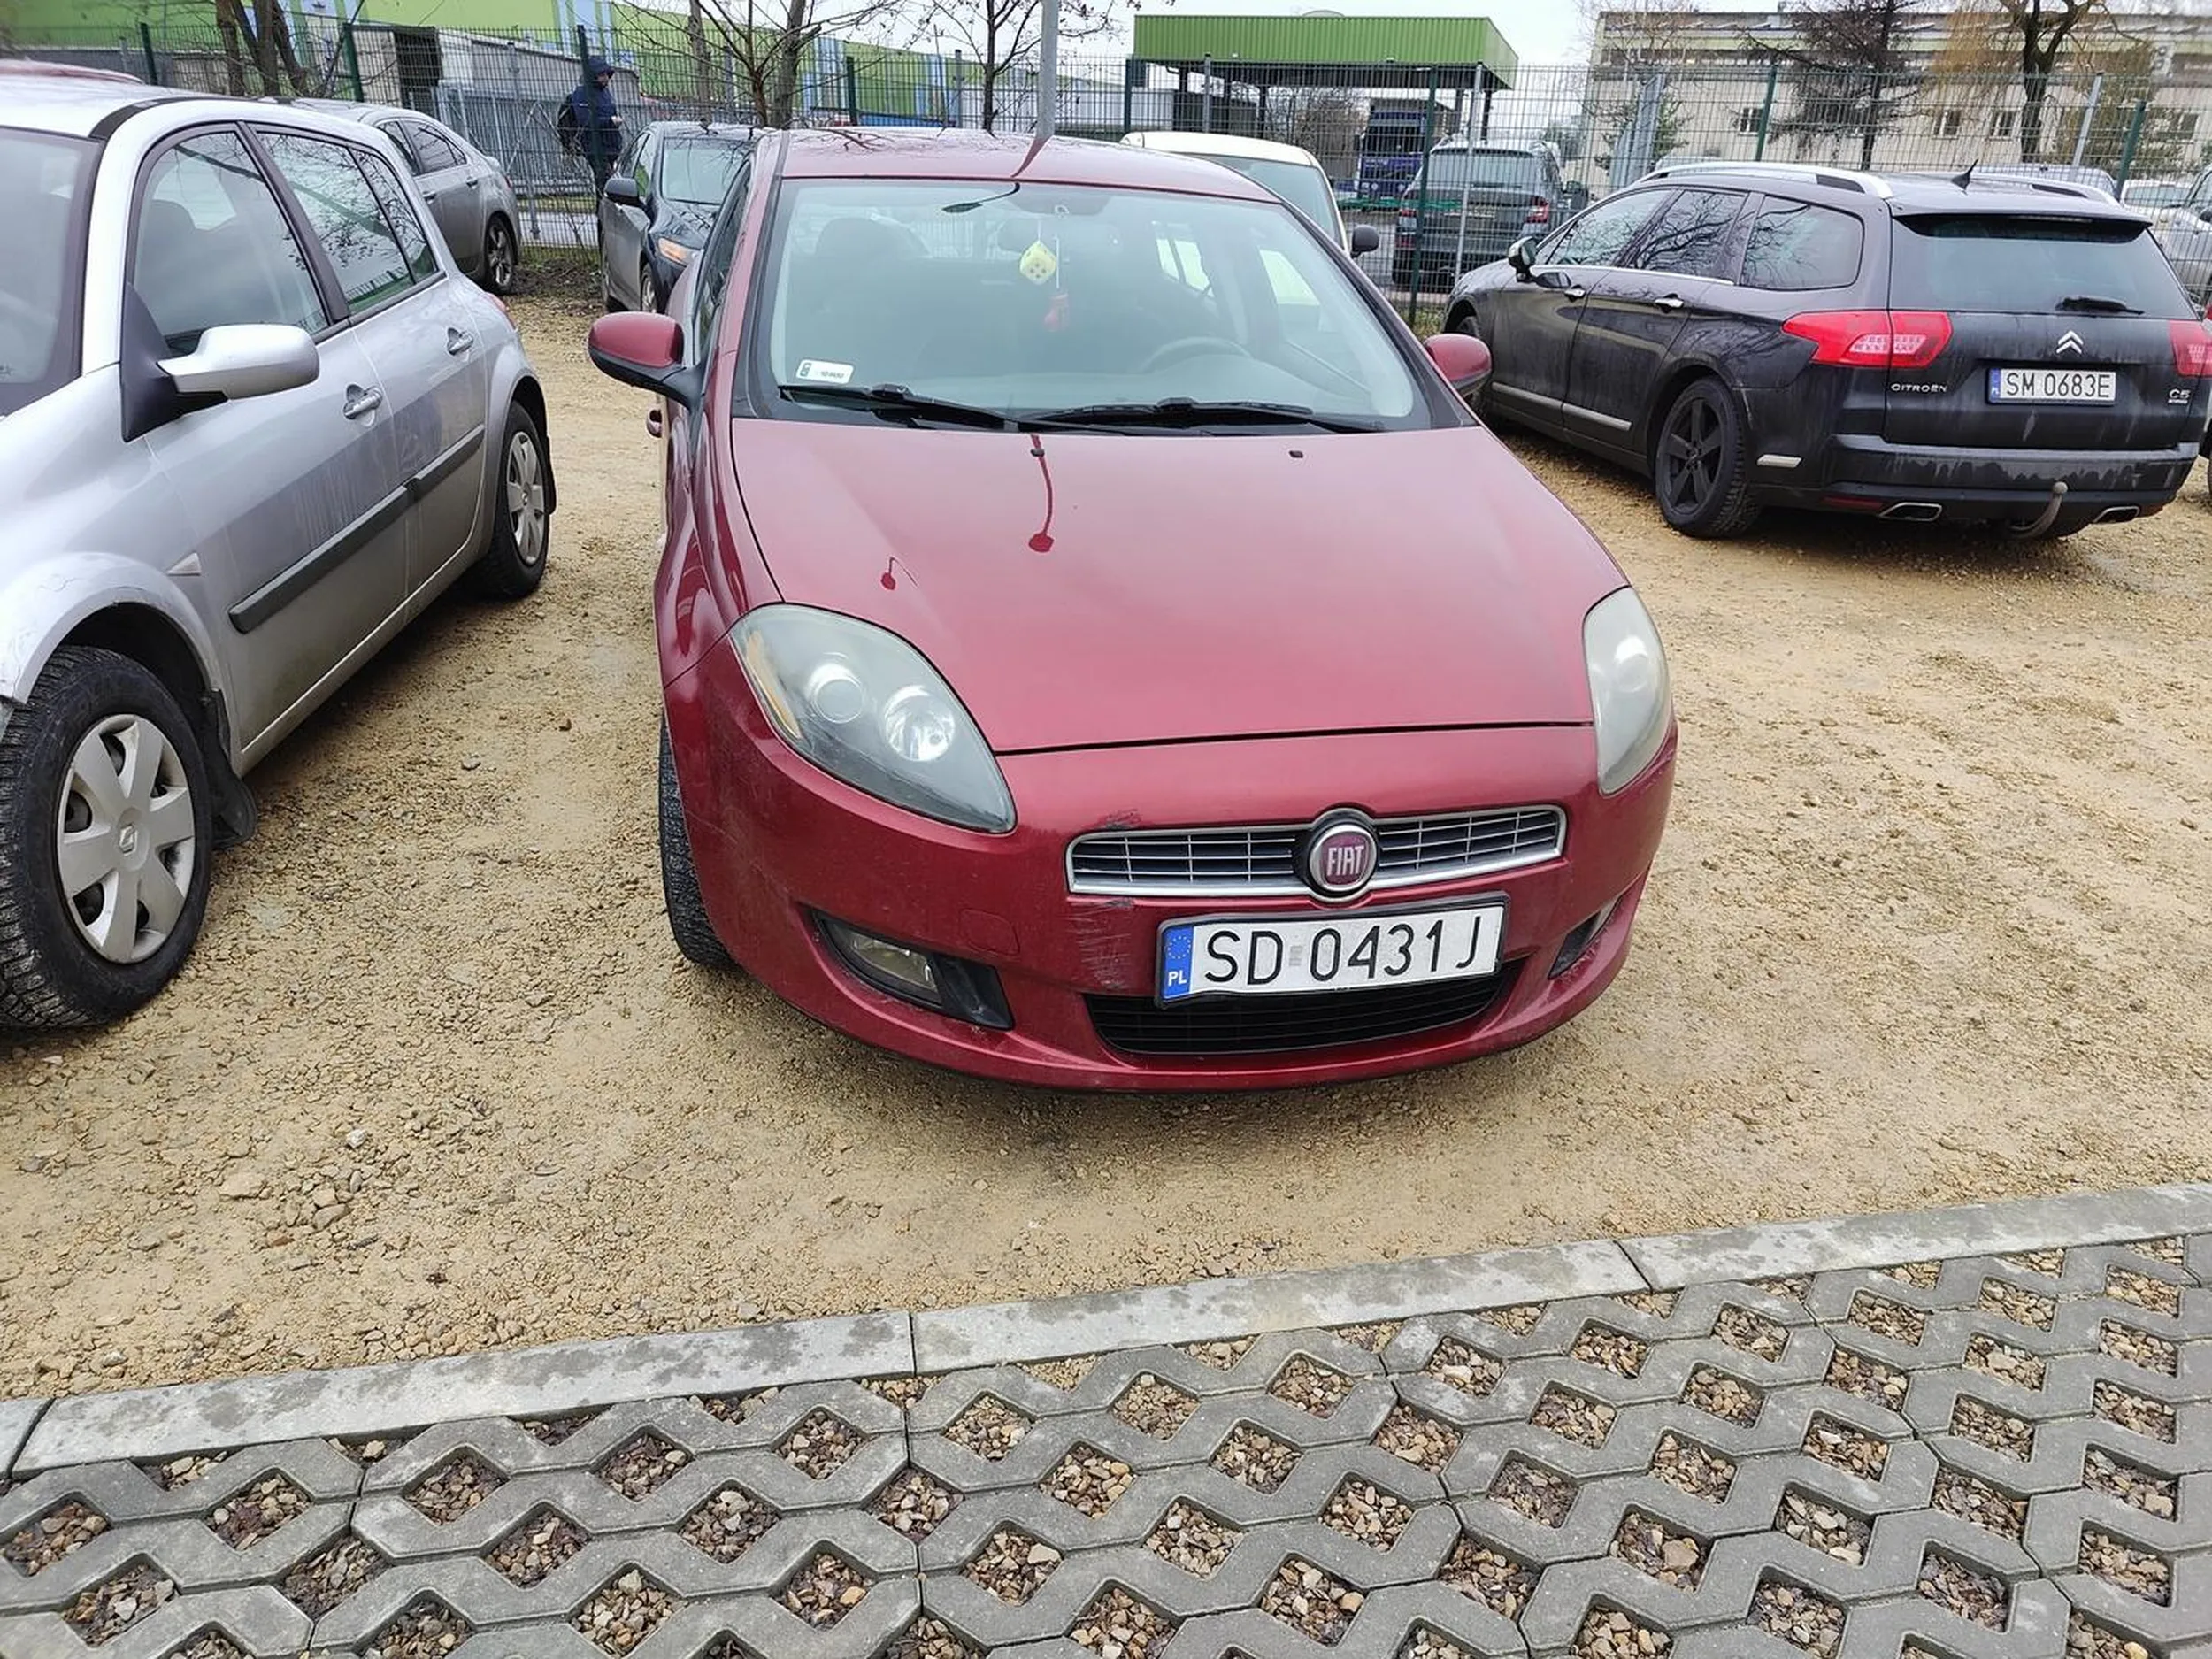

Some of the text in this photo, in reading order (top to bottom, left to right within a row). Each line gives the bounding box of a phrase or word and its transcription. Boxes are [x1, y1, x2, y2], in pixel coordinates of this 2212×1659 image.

[2006, 372, 2110, 398] SM 0683E
[2169, 388, 2192, 399] C5
[1326, 845, 1365, 877] FIAT
[1204, 916, 1482, 986] SD 0431J
[1168, 970, 1187, 987] PL
